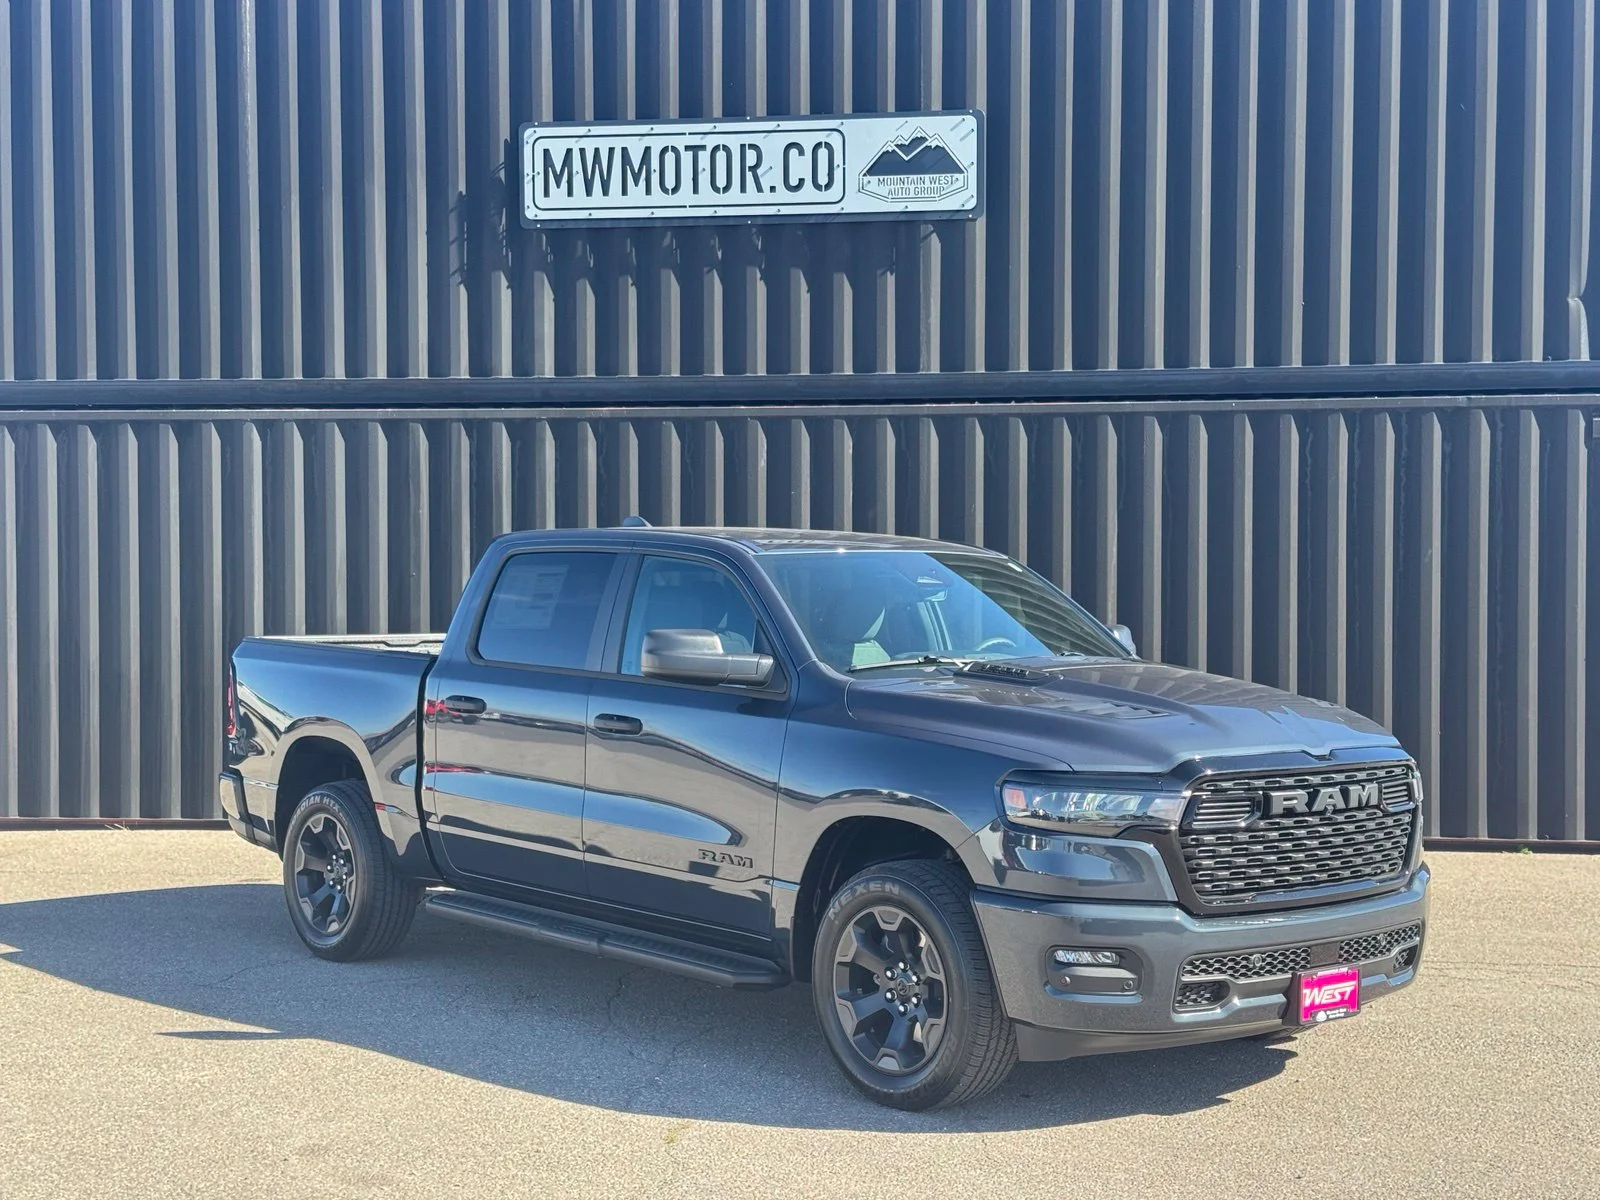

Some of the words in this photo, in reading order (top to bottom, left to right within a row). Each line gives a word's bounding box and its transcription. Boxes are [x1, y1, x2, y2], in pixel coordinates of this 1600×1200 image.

[542, 141, 834, 198] MWMOTOR.CO
[878, 175, 926, 187] MOUNTAIN
[929, 175, 955, 185] WEST
[888, 186, 911, 196] AUTO
[913, 186, 945, 196] GROUP
[1266, 782, 1379, 815] RAM
[698, 848, 753, 868] RAM
[828, 881, 900, 920] NEXEN
[1303, 981, 1357, 1006] WEST
